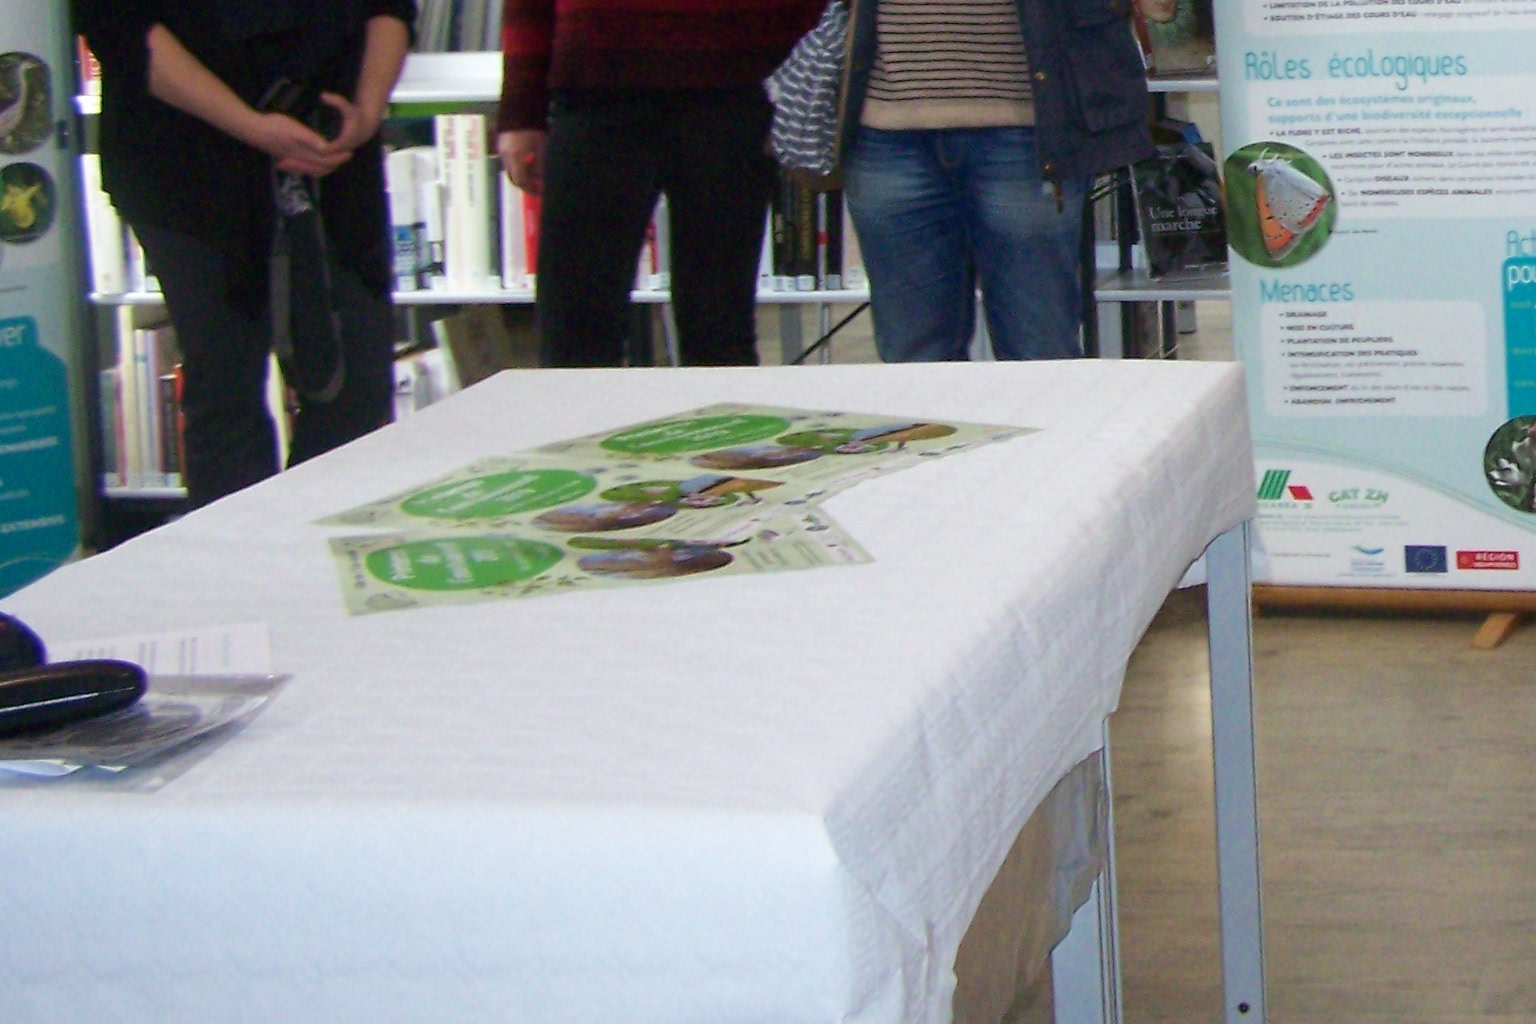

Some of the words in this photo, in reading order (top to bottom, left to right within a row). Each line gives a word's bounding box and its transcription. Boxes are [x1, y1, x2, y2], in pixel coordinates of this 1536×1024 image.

[1245, 50, 1311, 80] Rôles
[1330, 47, 1467, 90] écologiques
[1259, 278, 1355, 303] Menaces
